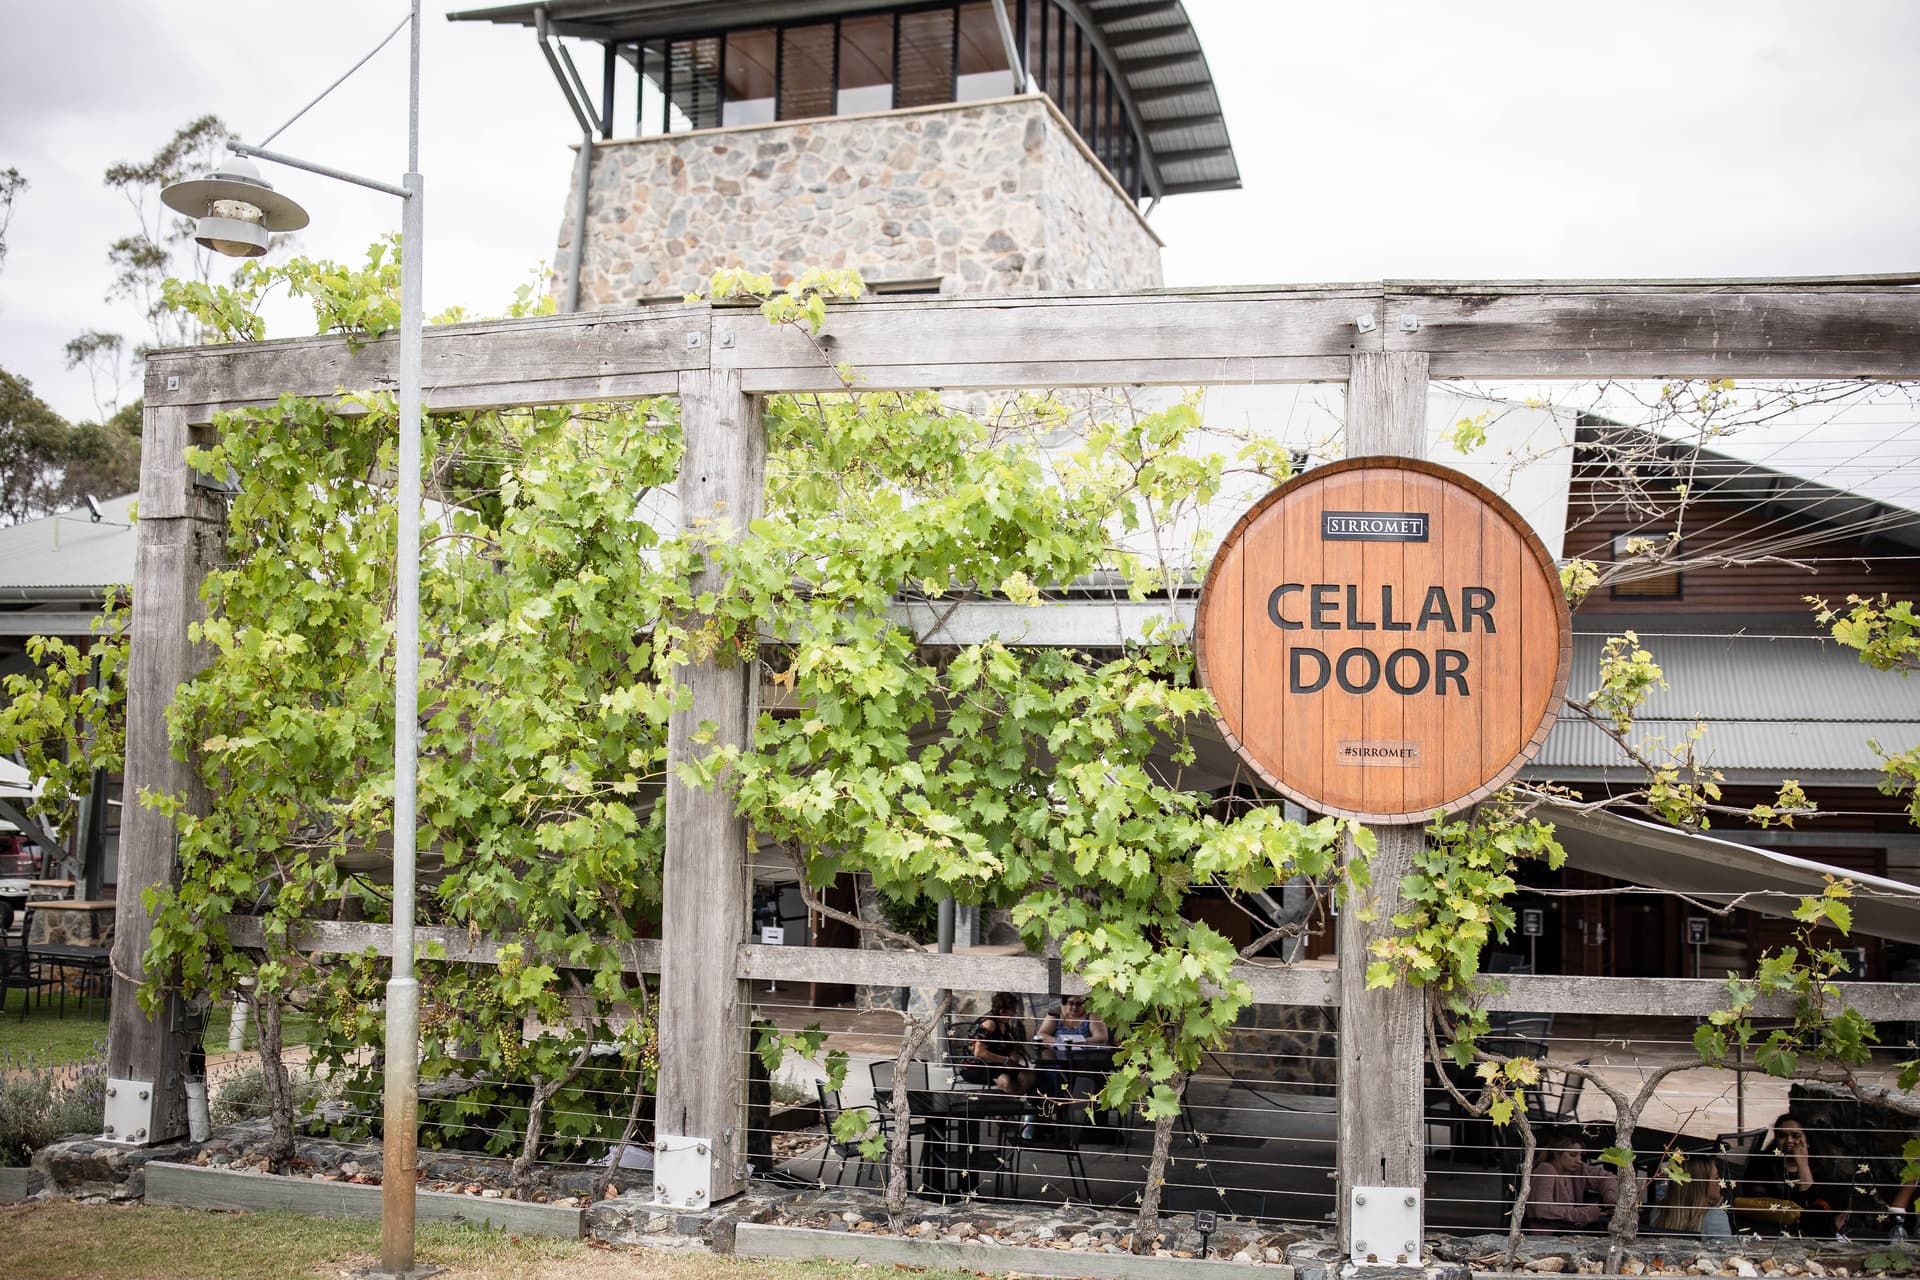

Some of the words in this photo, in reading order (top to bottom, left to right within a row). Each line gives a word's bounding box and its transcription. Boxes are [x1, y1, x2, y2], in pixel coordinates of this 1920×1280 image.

[1331, 519, 1420, 533] SIRROMET
[1267, 583, 1497, 633] CELLAR
[1289, 647, 1470, 696] DOOR
[1344, 746, 1413, 758] #SIRROMET
